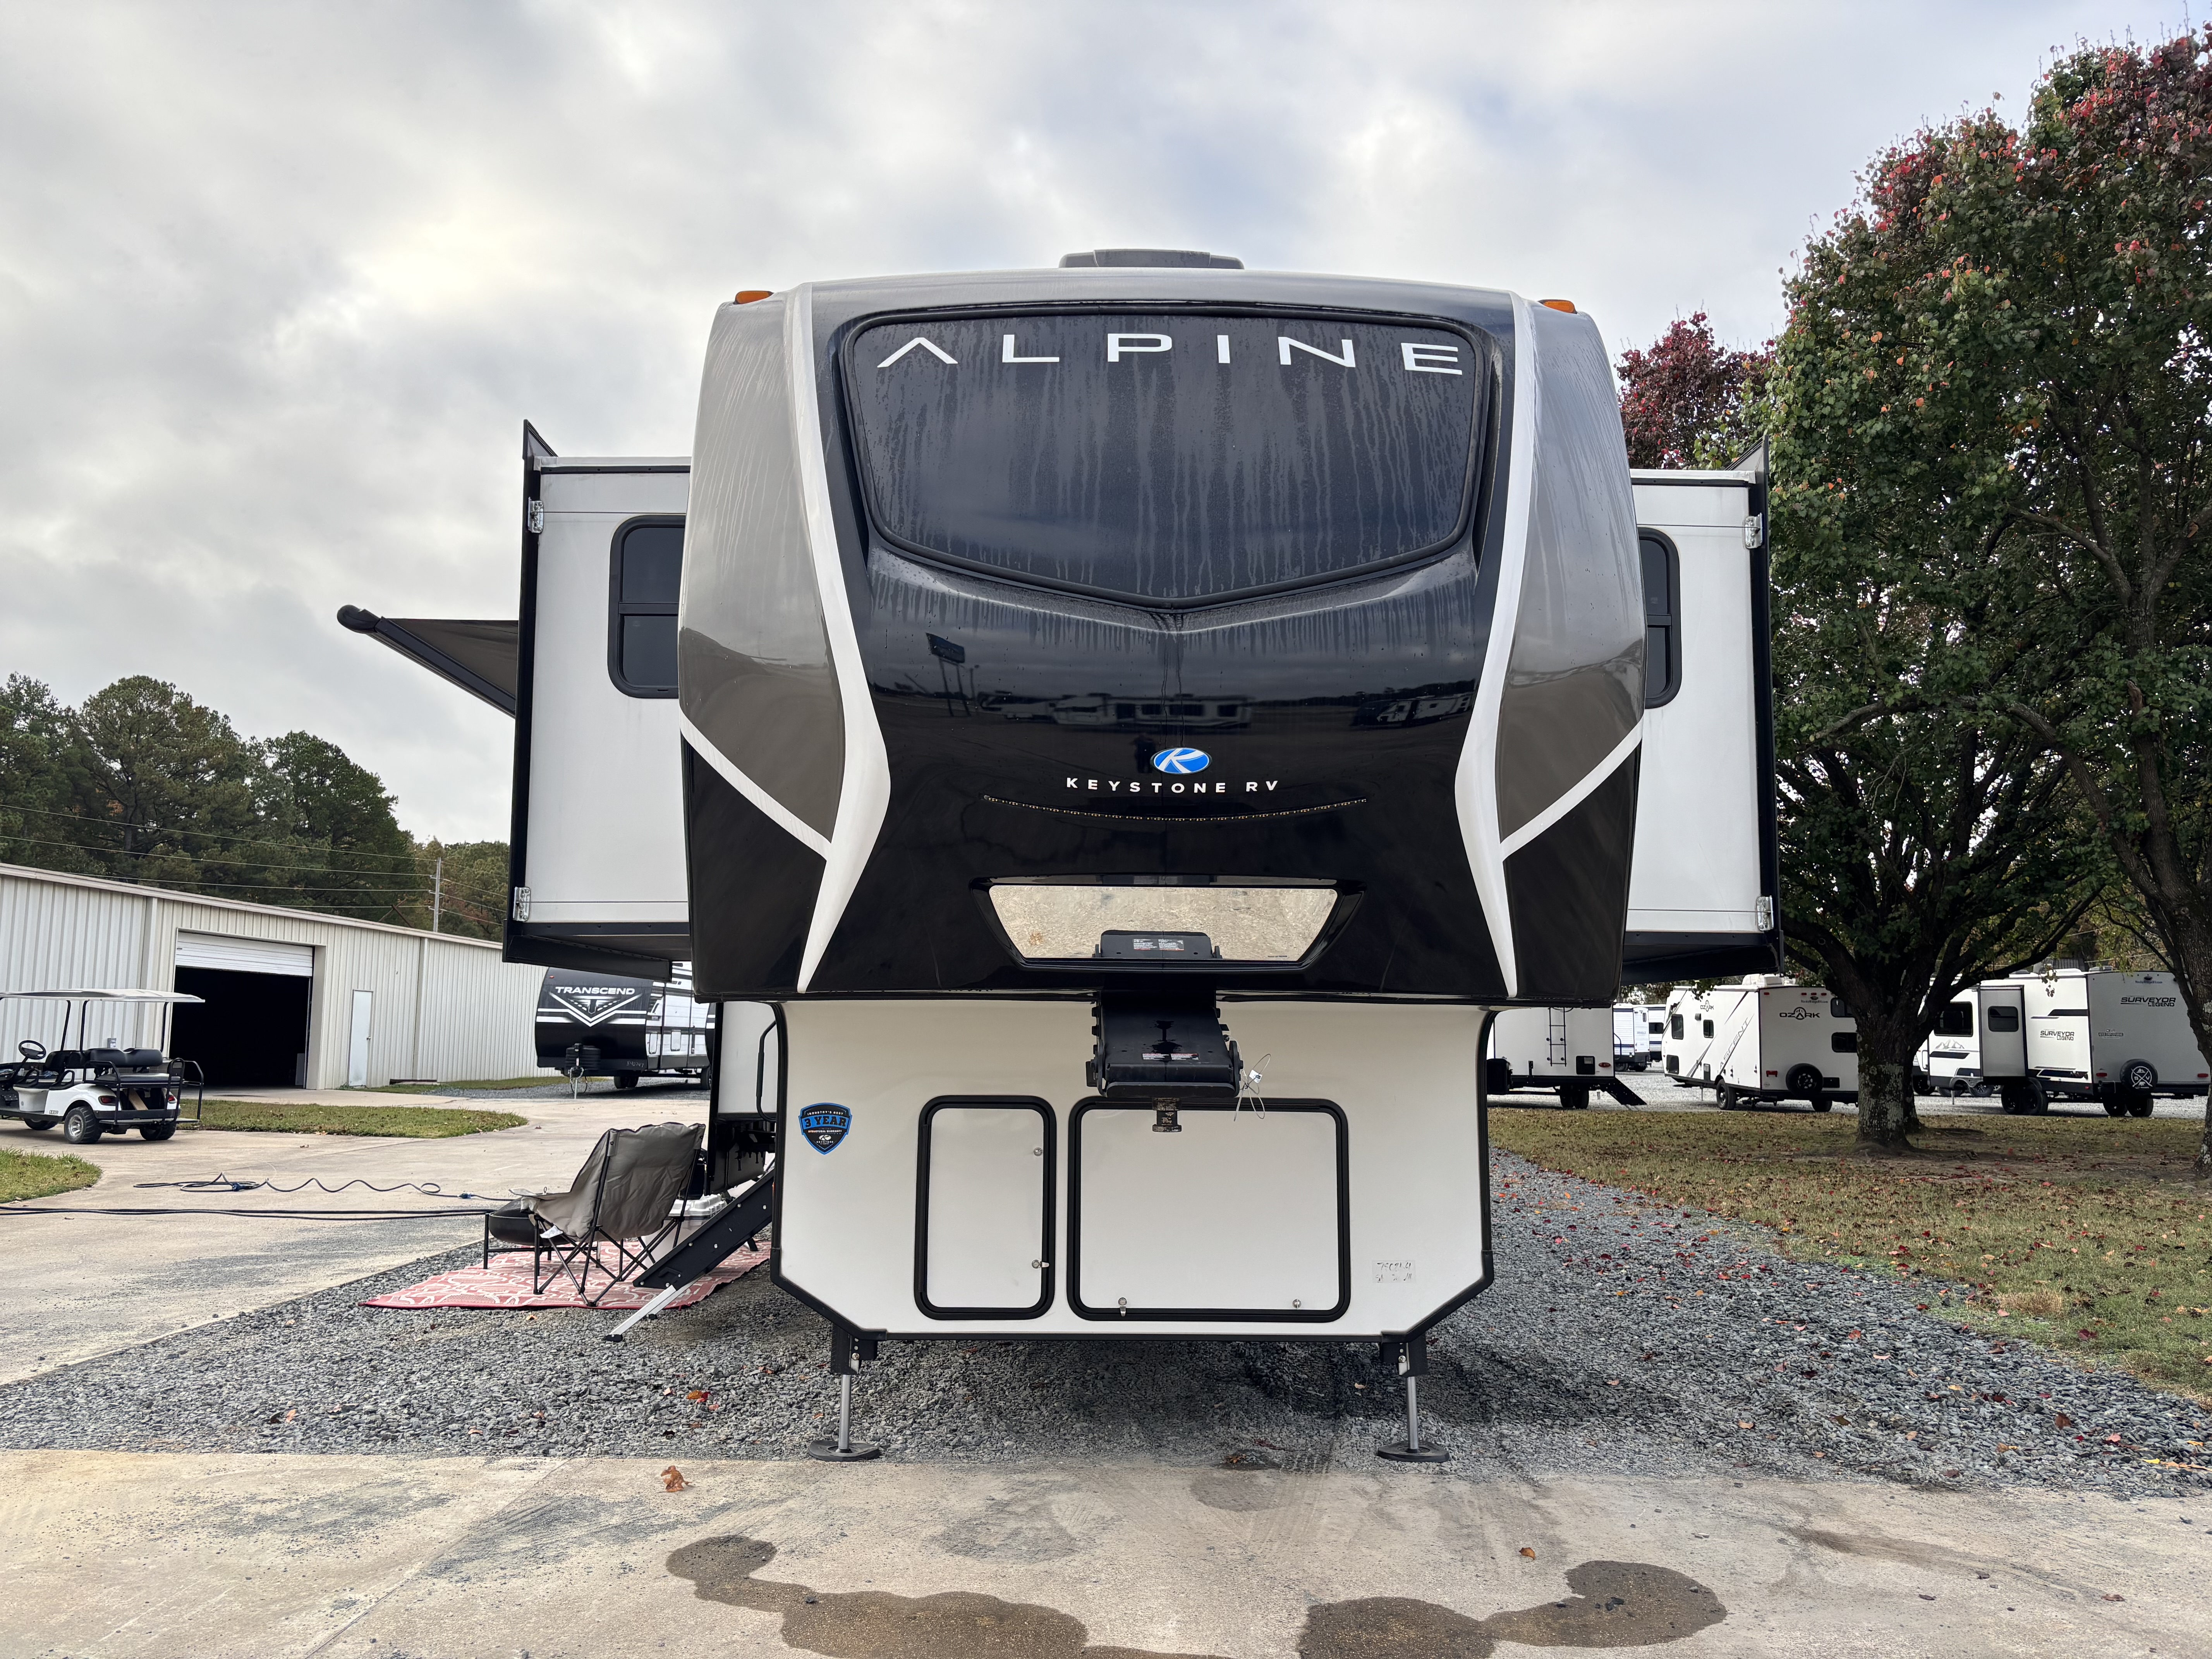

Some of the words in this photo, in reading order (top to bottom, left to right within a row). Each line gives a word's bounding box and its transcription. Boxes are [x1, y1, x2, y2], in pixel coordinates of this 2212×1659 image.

[877, 333, 1463, 375] ALPINE
[1066, 777, 1226, 794] KEYSTONE
[1245, 780, 1278, 792] RV
[555, 986, 635, 995] TRANSCEND
[1779, 1009, 1820, 1020] OZARK
[1720, 1017, 1748, 1070] ASCENT
[804, 1118, 811, 1127] 3
[814, 1116, 847, 1127] YEAR
